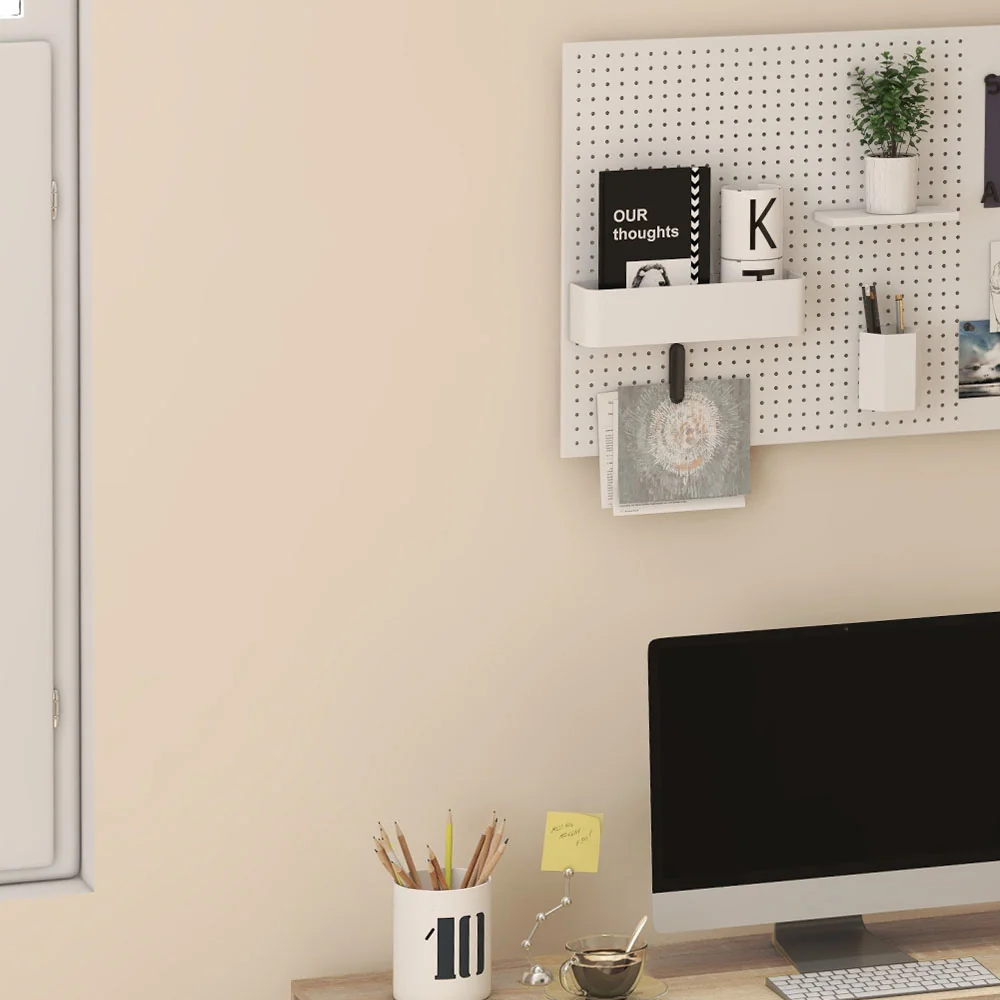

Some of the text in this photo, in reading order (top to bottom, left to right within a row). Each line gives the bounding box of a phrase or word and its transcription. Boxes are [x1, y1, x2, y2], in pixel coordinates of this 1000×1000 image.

[613, 208, 648, 222] OUR
[750, 197, 777, 250] K
[612, 225, 680, 242] thoughts
[425, 912, 484, 980] 10
